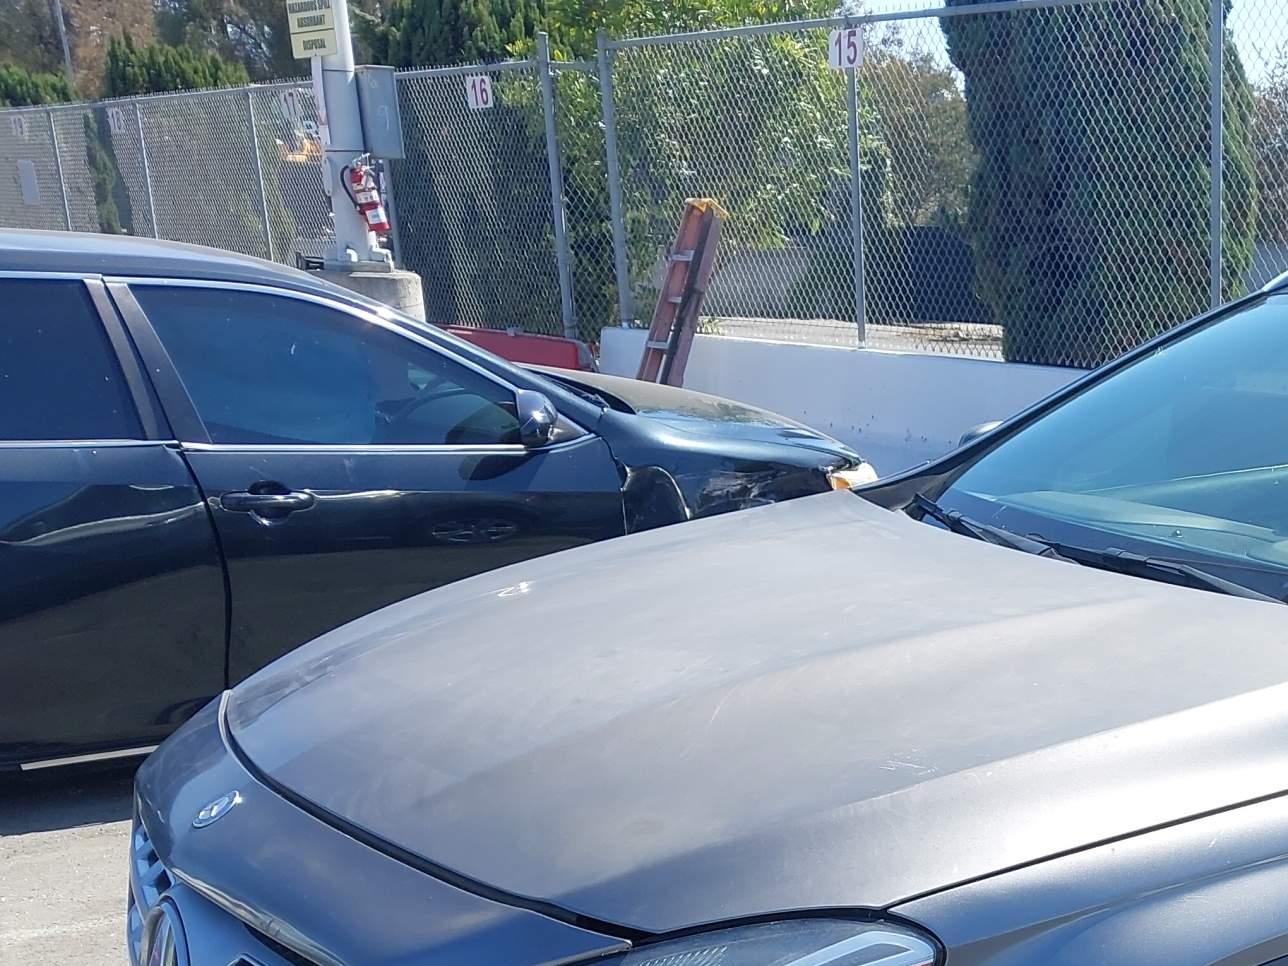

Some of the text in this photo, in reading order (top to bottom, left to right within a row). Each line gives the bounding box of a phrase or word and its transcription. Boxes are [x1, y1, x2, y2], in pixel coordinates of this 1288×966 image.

[303, 38, 327, 51] DISPOSAL
[834, 30, 858, 67] 15
[283, 91, 297, 117] 17
[471, 77, 489, 107] 16
